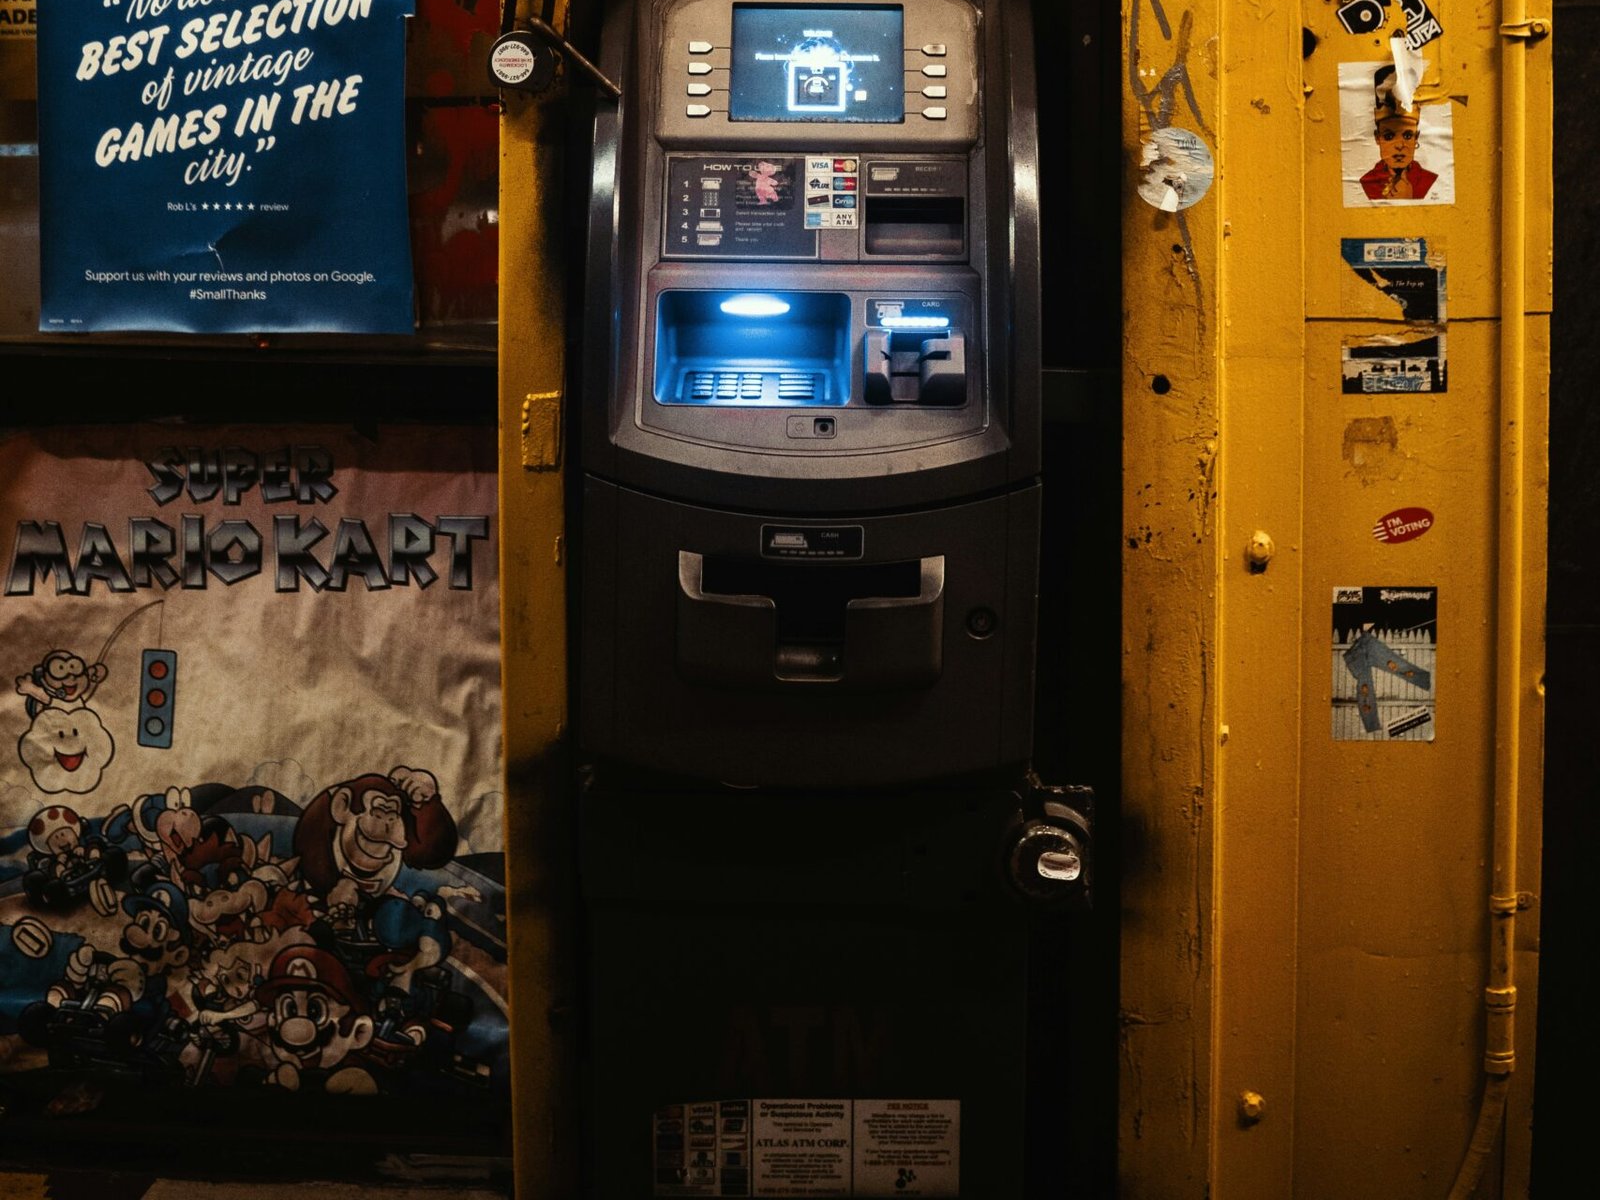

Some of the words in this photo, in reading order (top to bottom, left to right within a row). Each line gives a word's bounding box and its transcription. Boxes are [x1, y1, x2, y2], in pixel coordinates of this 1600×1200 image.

[76, 26, 170, 82] BEST
[141, 66, 176, 110] of
[184, 46, 314, 97] vintage
[95, 103, 227, 168] GAMES
[234, 92, 281, 137] IN
[292, 74, 363, 125] THE
[682, 194, 689, 202] 2
[167, 202, 183, 211] Rob
[260, 202, 289, 212] review
[681, 221, 688, 229] 4
[681, 235, 688, 243] 5
[85, 270, 129, 283] Support
[130, 272, 144, 281] us
[146, 270, 171, 281] with
[173, 272, 197, 284] your
[199, 270, 243, 282] reviews
[246, 270, 268, 281] and
[270, 270, 311, 283] photos
[313, 272, 328, 281] on
[331, 270, 376, 283] Google.
[190, 288, 266, 300] #SmallThanks
[145, 445, 338, 506] SUPER
[1386, 517, 1402, 527] I'M
[1390, 518, 1431, 537] VOTING
[4, 513, 263, 596] MARIO
[273, 513, 489, 593] KART
[760, 1102, 805, 1110] Operational
[815, 1111, 844, 1119] Activity
[756, 1139, 789, 1147] ATLAS
[792, 1139, 815, 1147] ATM
[817, 1139, 849, 1147] CORP.
